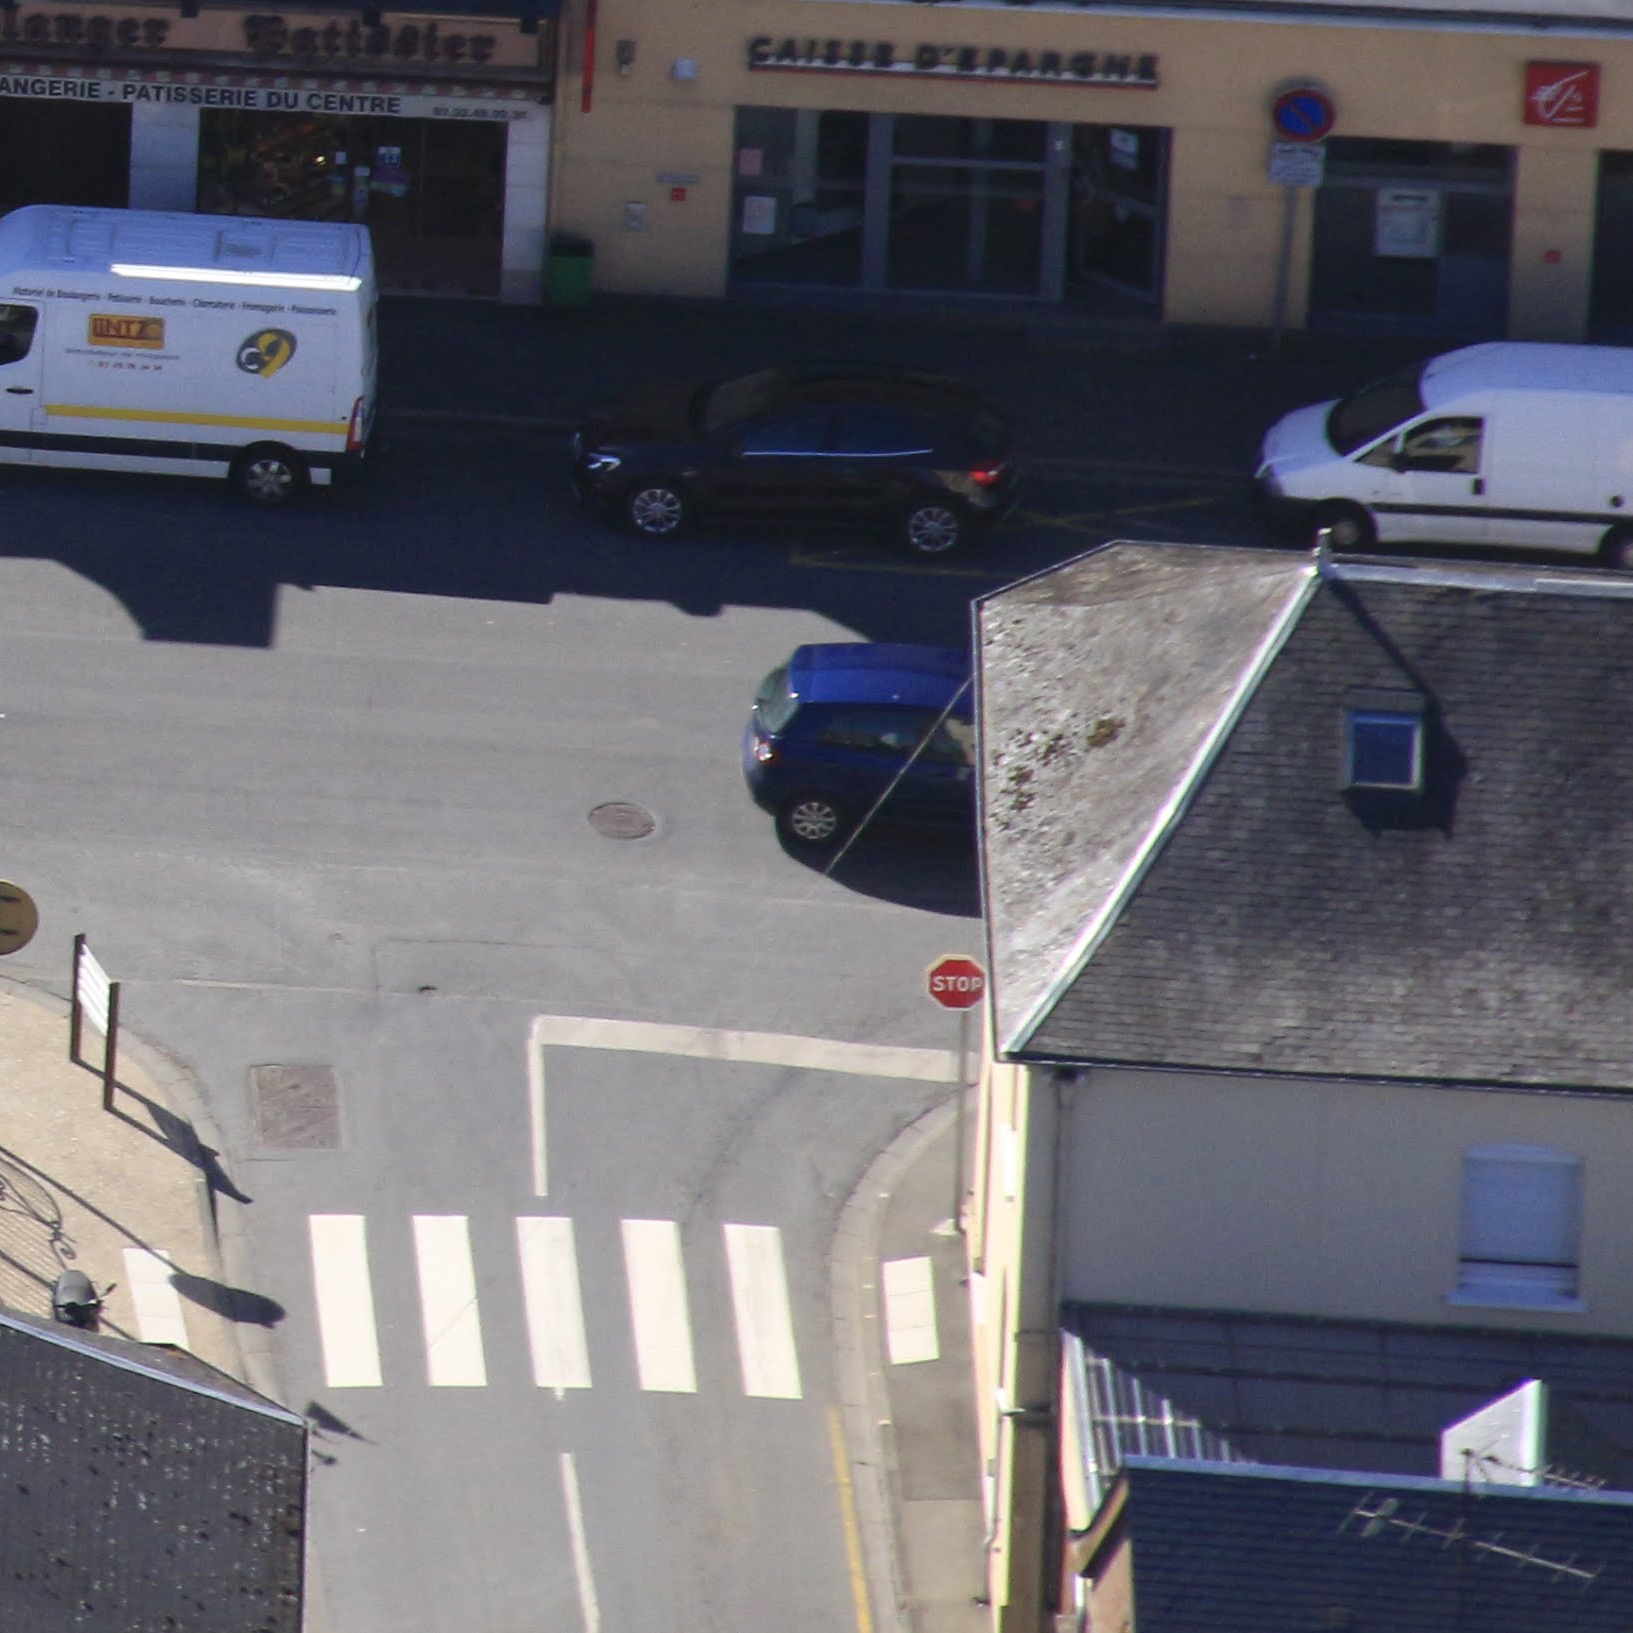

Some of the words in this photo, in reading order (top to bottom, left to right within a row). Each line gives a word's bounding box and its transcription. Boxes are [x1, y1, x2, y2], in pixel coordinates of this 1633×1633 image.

[748, 36, 895, 69] CAISSE
[915, 43, 1158, 81] D'EPARGNE
[122, 83, 256, 108] PATISSERIE
[266, 91, 300, 110] DU
[307, 92, 402, 114] CENTRE
[933, 975, 984, 992] STOP
